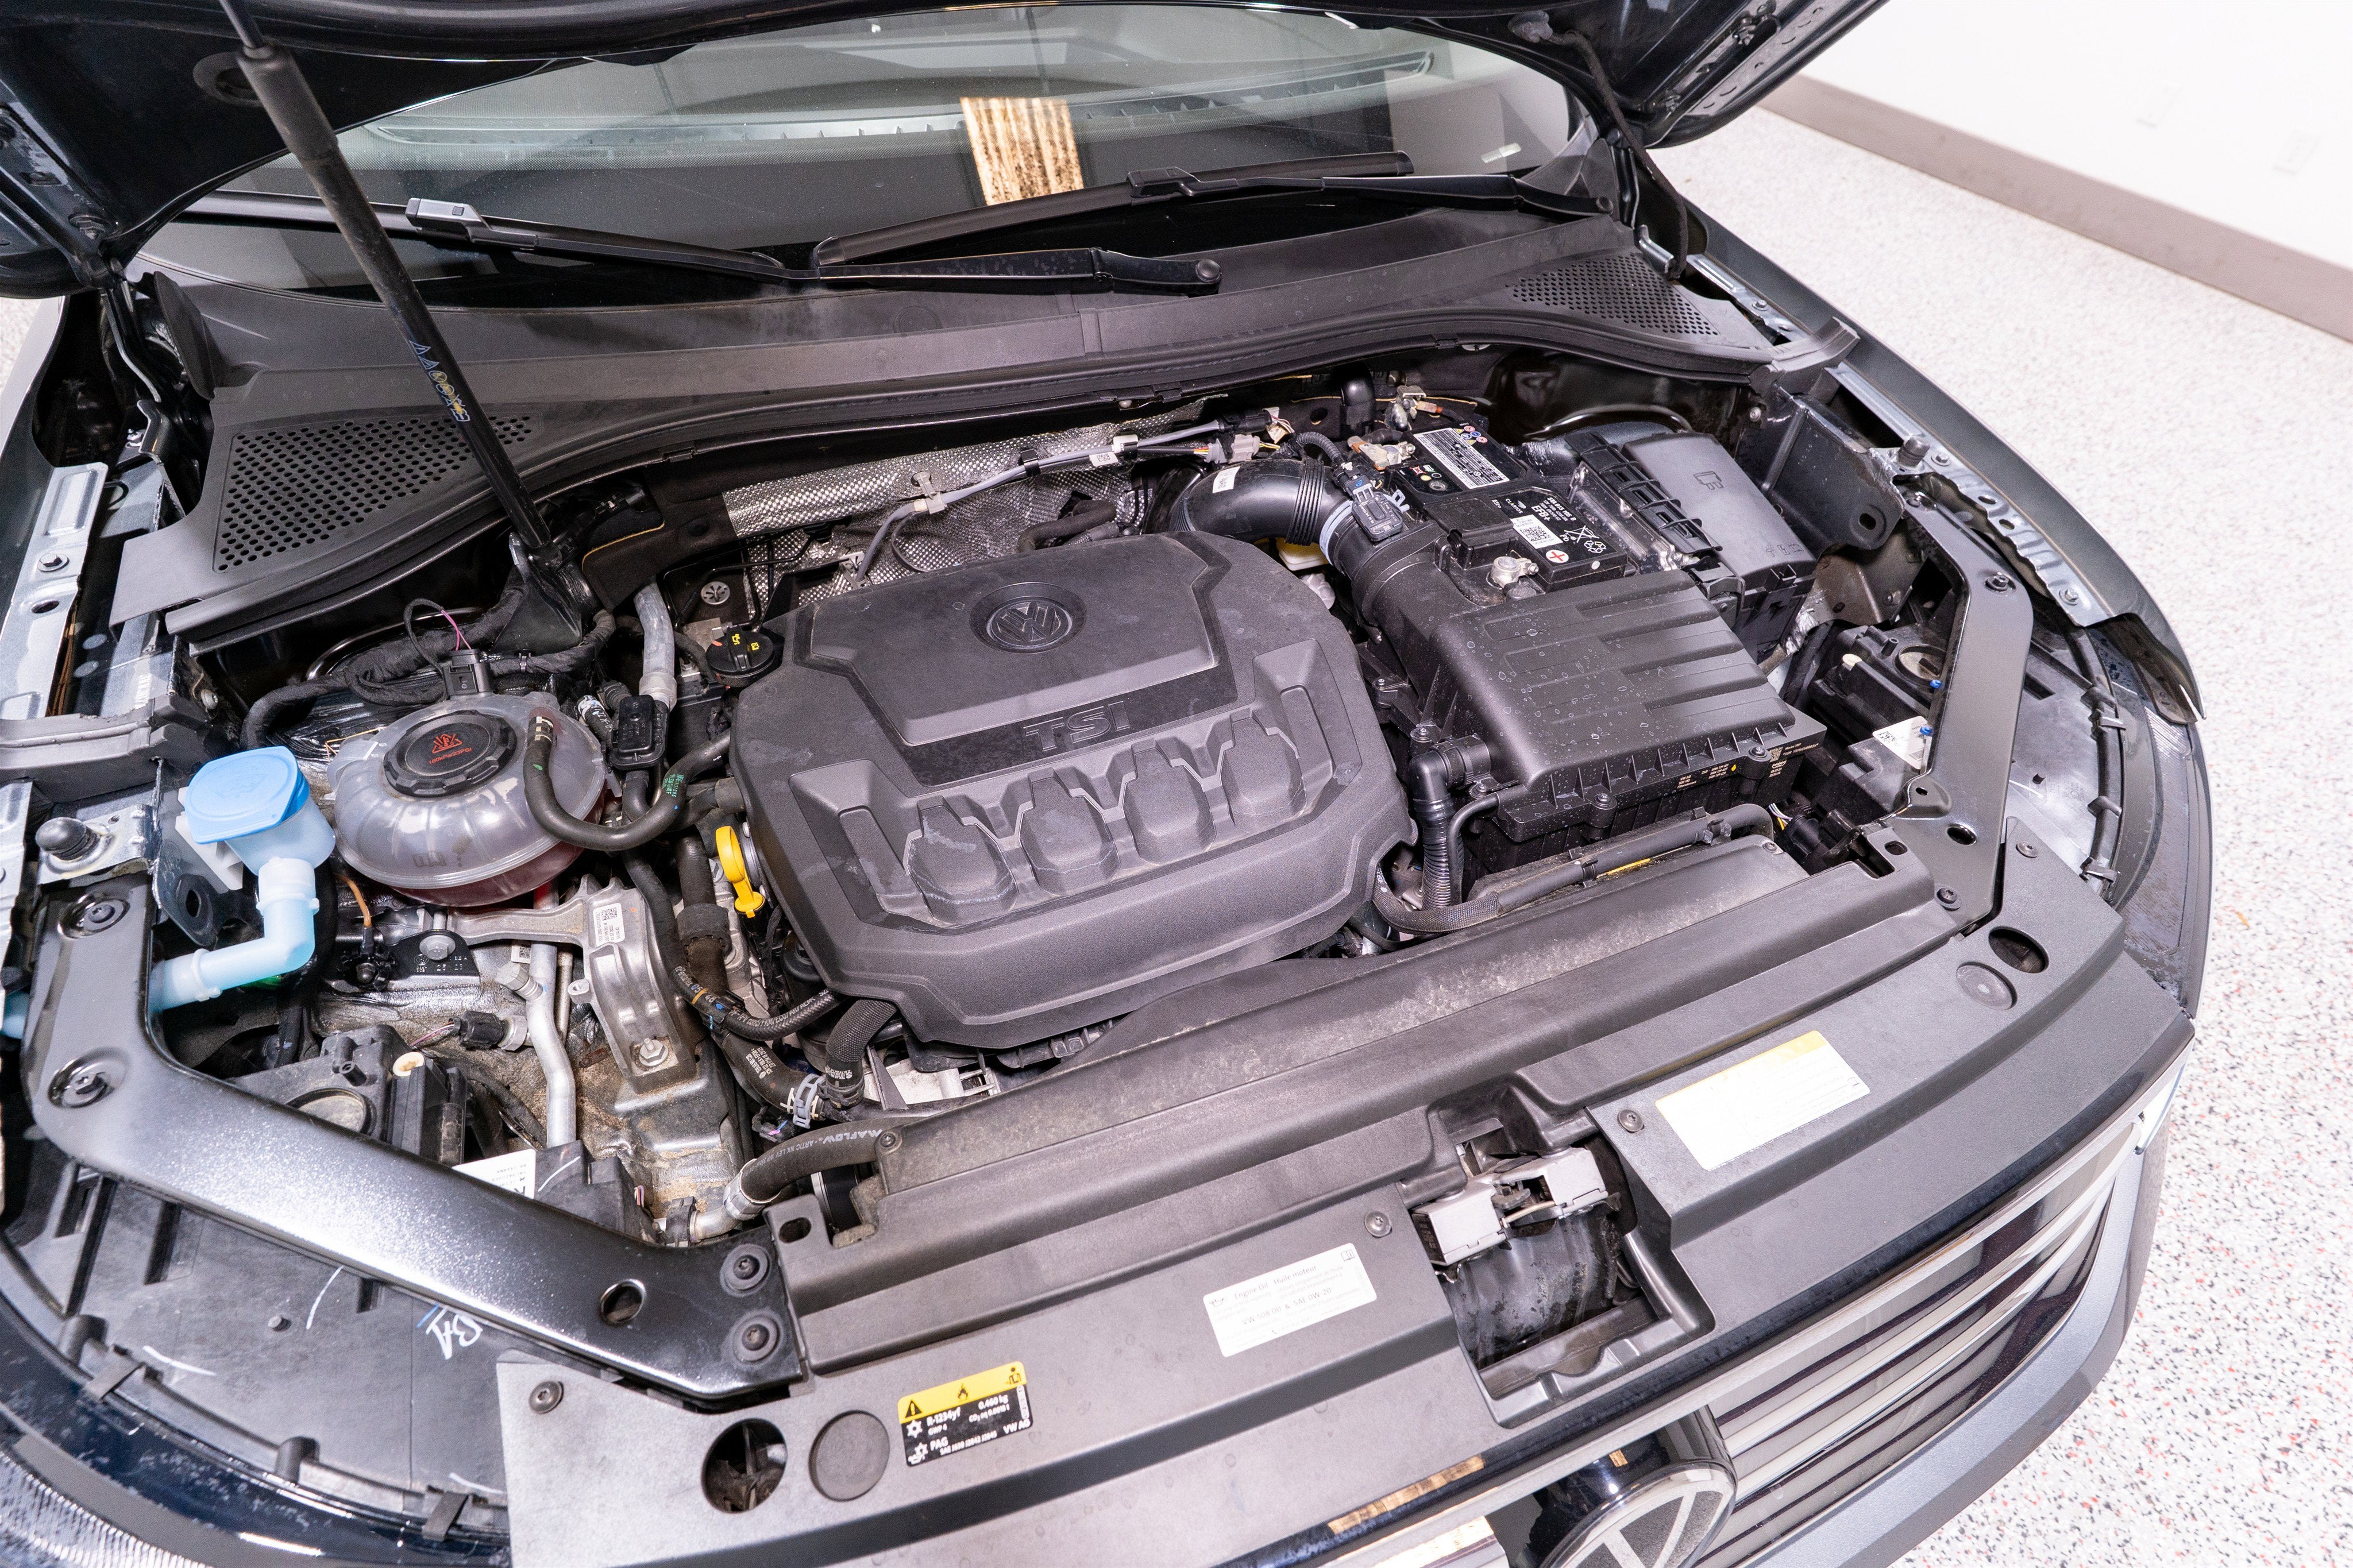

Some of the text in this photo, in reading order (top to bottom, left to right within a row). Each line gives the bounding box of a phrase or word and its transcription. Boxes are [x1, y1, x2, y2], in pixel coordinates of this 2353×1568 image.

[1505, 498, 1523, 514] CLARIOS
[1532, 505, 1550, 522] EFB+
[1553, 503, 1565, 511] 915
[1024, 701, 1130, 752] TSI
[1274, 1266, 1317, 1284] Huile moteur
[1234, 1286, 1259, 1300] Engine
[1242, 1316, 1255, 1324] VW
[1257, 1310, 1271, 1319] 508
[1293, 1297, 1306, 1305] SAE
[926, 1406, 961, 1426] R-1234yf
[1003, 1419, 1030, 1434] VW AG
[930, 1436, 948, 1451] PAG
